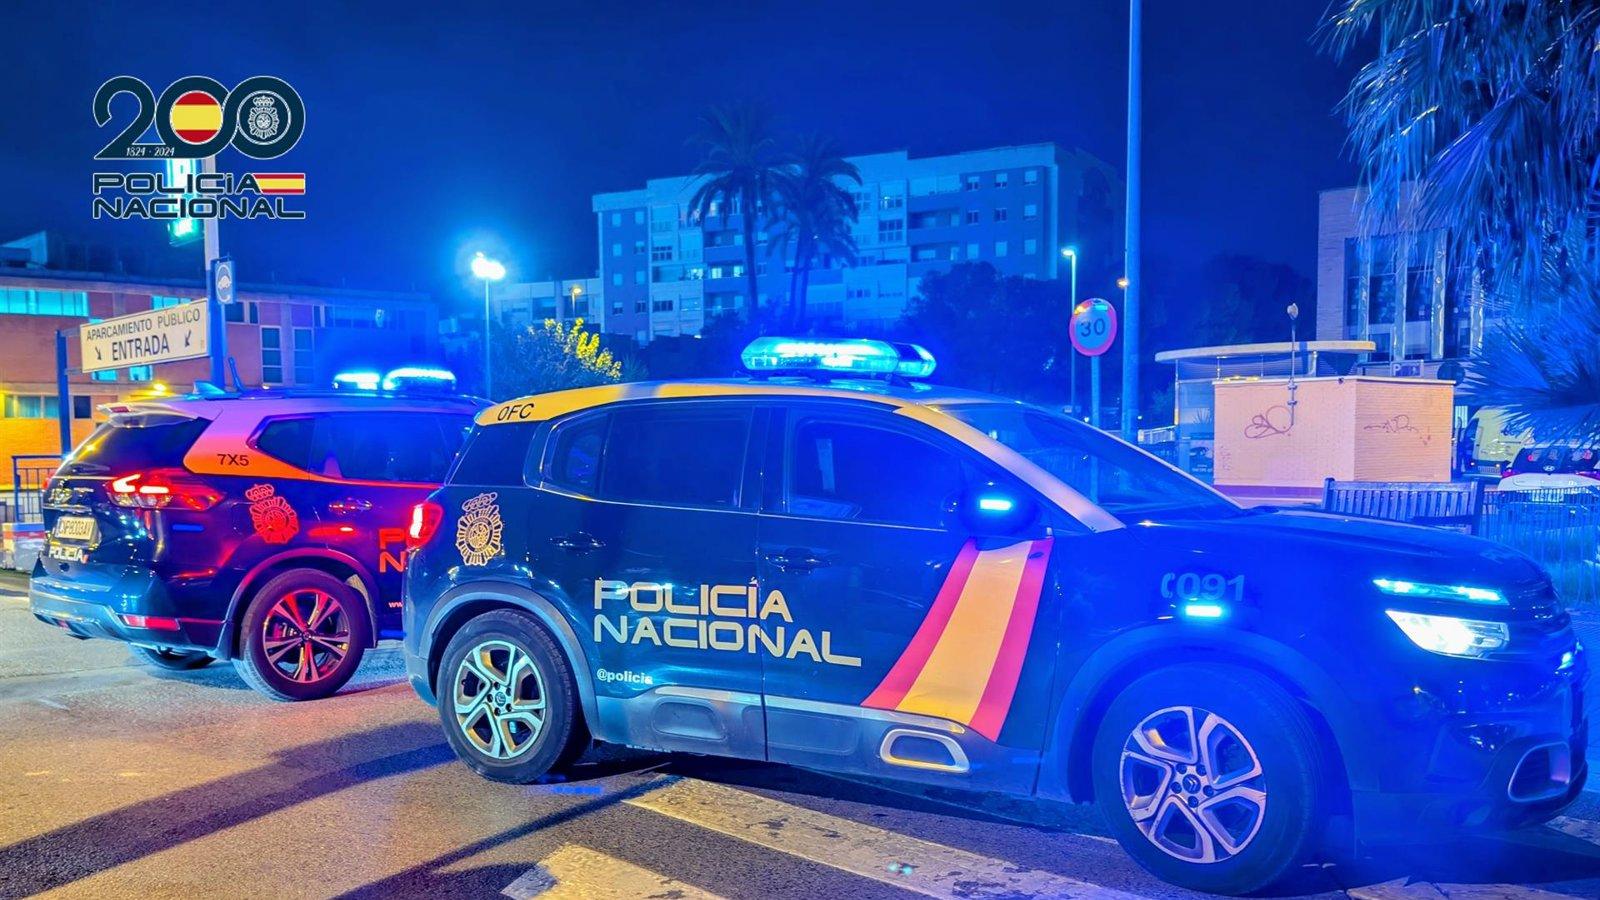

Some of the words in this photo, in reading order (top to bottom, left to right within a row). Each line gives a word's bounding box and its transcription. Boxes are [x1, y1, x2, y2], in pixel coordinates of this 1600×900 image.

[86, 318, 153, 342] APARCAMIENTO
[1080, 318, 1106, 337] 30
[111, 332, 170, 362] ENTRADA
[217, 453, 250, 467] 7X5
[1176, 572, 1246, 602] 091
[594, 613, 862, 667] NACIONAL
[596, 668, 654, 685] @policia
